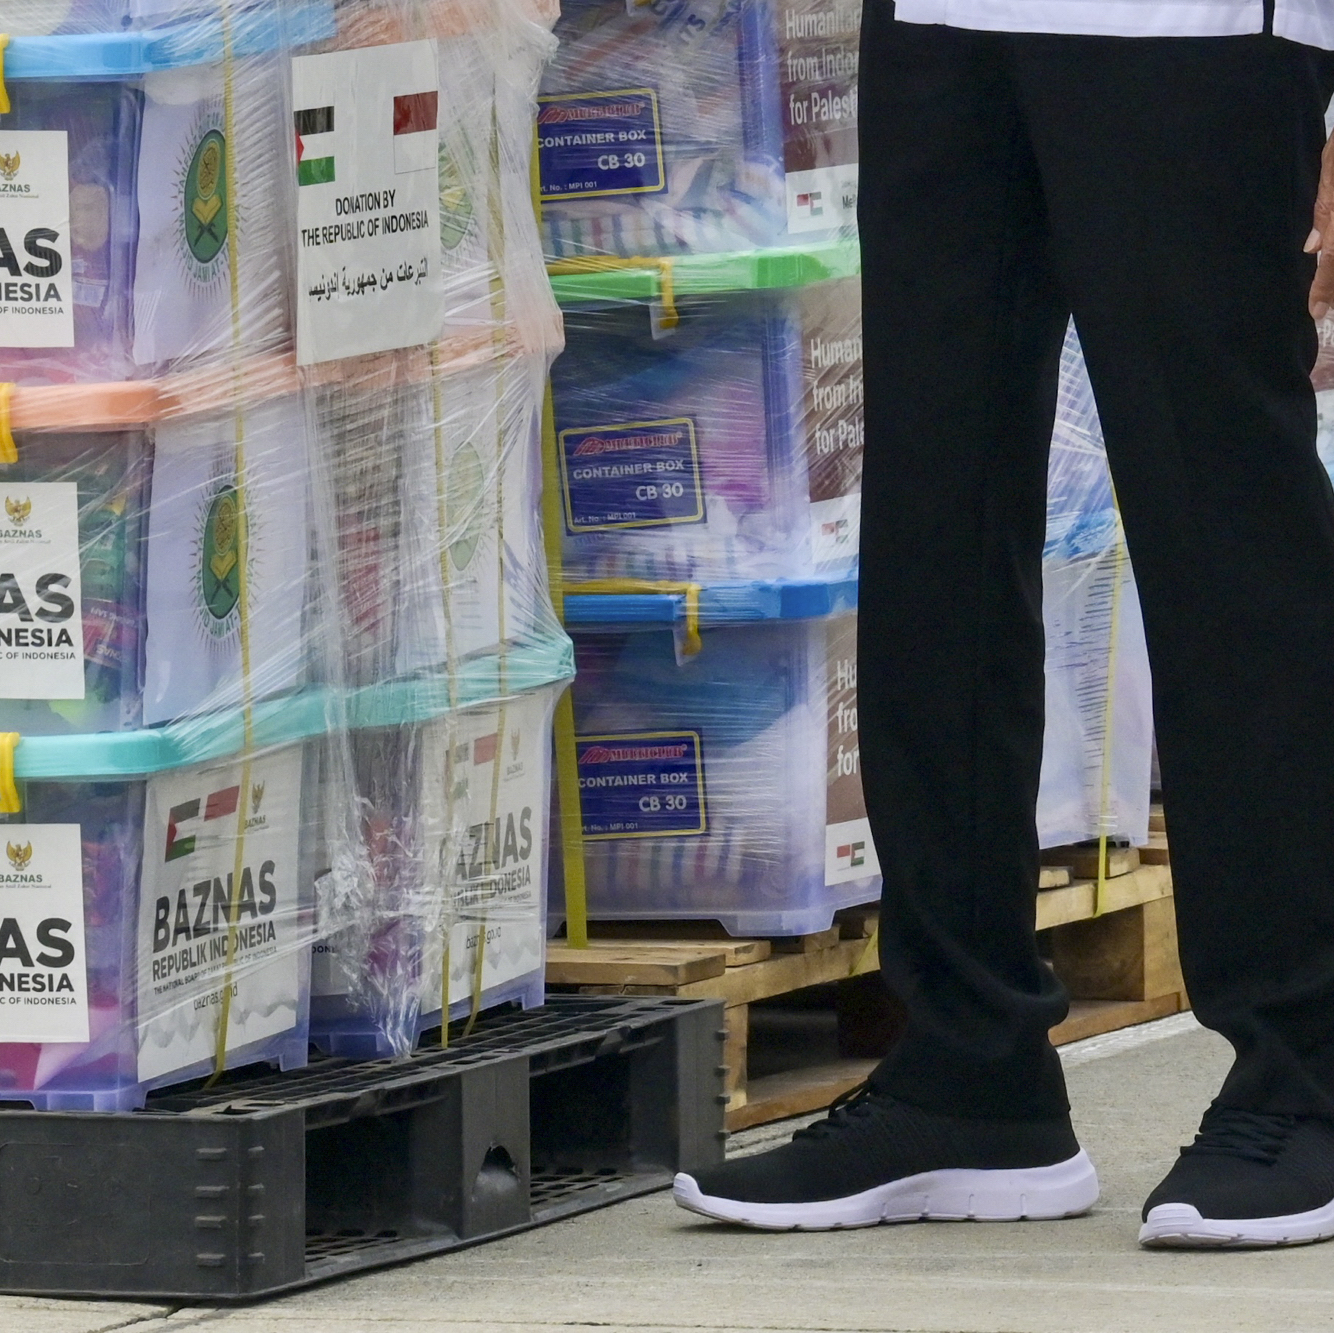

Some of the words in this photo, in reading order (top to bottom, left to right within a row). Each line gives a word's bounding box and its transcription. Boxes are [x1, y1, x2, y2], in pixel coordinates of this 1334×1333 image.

[789, 96, 808, 126] for
[619, 129, 647, 142] BOX
[598, 154, 621, 171] CB
[624, 152, 645, 168] 30
[568, 181, 583, 190] MPI
[584, 180, 597, 189] 001
[335, 192, 381, 216] DONATION
[383, 189, 396, 208] BY
[301, 228, 321, 248] THE
[321, 221, 365, 245] REPUBLIC
[367, 219, 380, 237] OF
[382, 210, 429, 235] INDONESIA
[342, 266, 377, 295] جمهورية
[380, 270, 394, 290] من
[573, 462, 652, 480] CONTAINER
[656, 458, 685, 473] BOX
[635, 484, 659, 502] CB
[662, 481, 684, 499] 30
[578, 773, 655, 790] CONTAINER
[660, 771, 689, 786] BOX
[639, 795, 662, 812] CB
[665, 794, 687, 811] 30
[153, 860, 277, 954] BAZNAS
[153, 943, 208, 983] REPUBLIK
[8, 997, 21, 1005] OF
[23, 997, 76, 1005] INDONESIA
